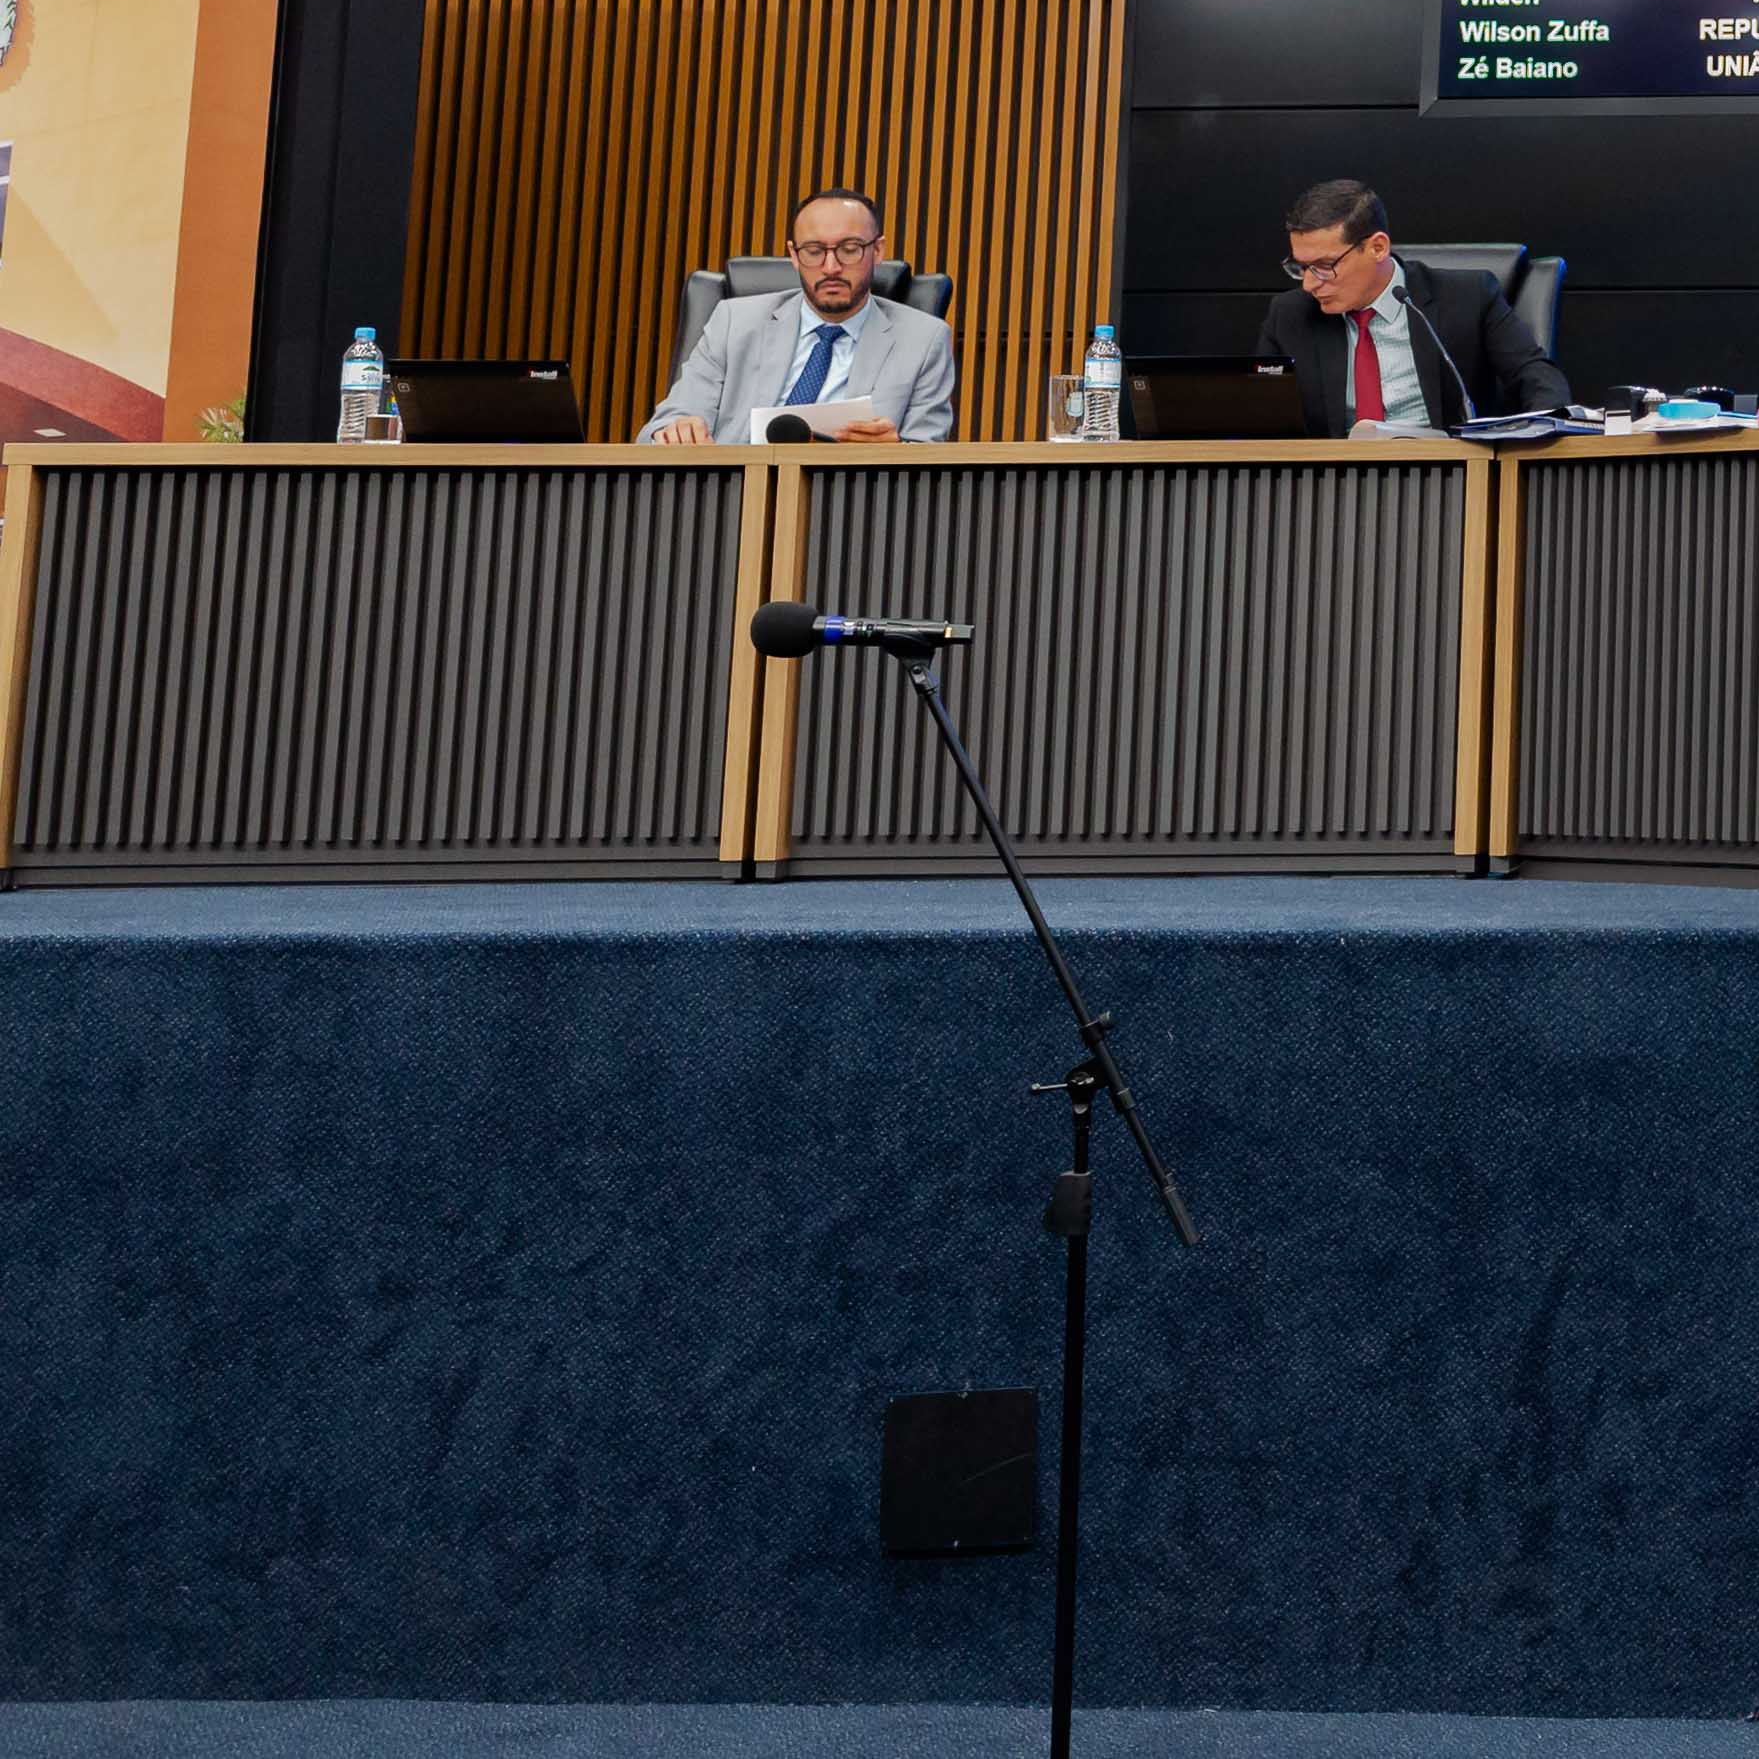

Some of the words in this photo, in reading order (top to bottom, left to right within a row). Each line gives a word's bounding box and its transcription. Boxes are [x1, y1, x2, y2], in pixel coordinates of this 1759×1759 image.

[1460, 21, 1541, 41] Wilson
[1548, 21, 1610, 41] Zuffa
[1459, 60, 1489, 79] Zé
[1496, 60, 1578, 79] Baiano
